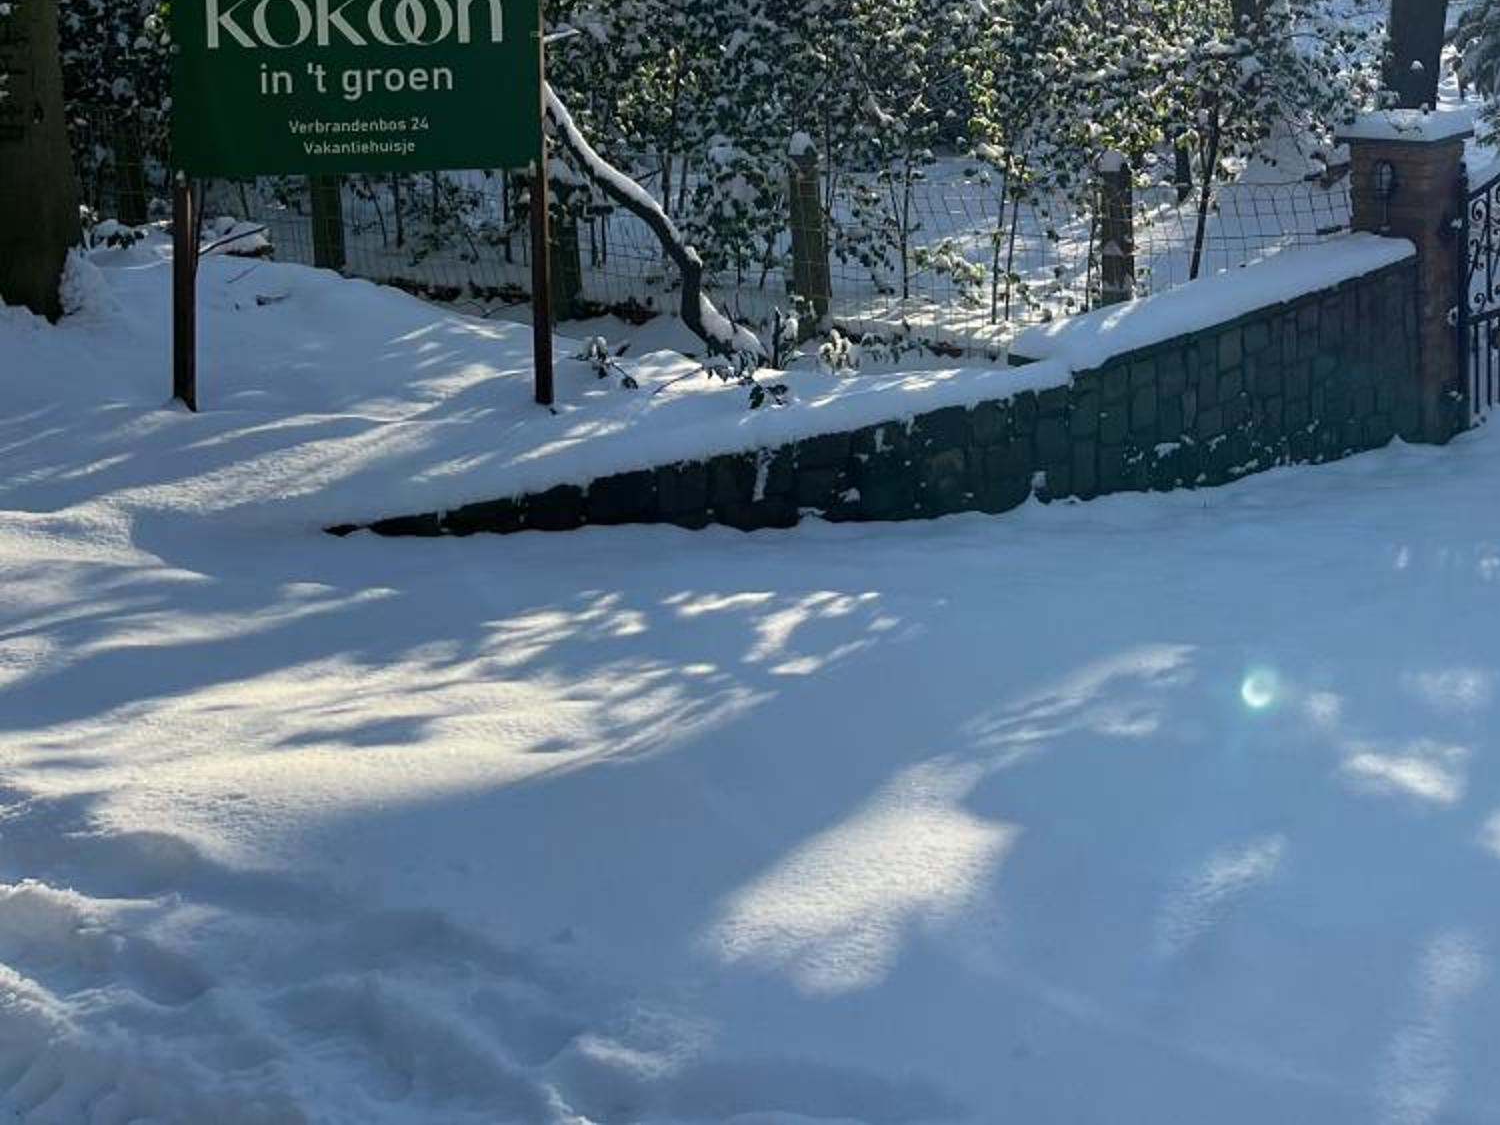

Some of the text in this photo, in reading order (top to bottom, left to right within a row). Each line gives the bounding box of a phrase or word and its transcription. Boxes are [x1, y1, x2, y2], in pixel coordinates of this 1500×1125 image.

[260, 62, 453, 101] in 't groen
[288, 116, 429, 134] Verbrandenbos 24
[303, 138, 416, 156] Vakantiehuisje
